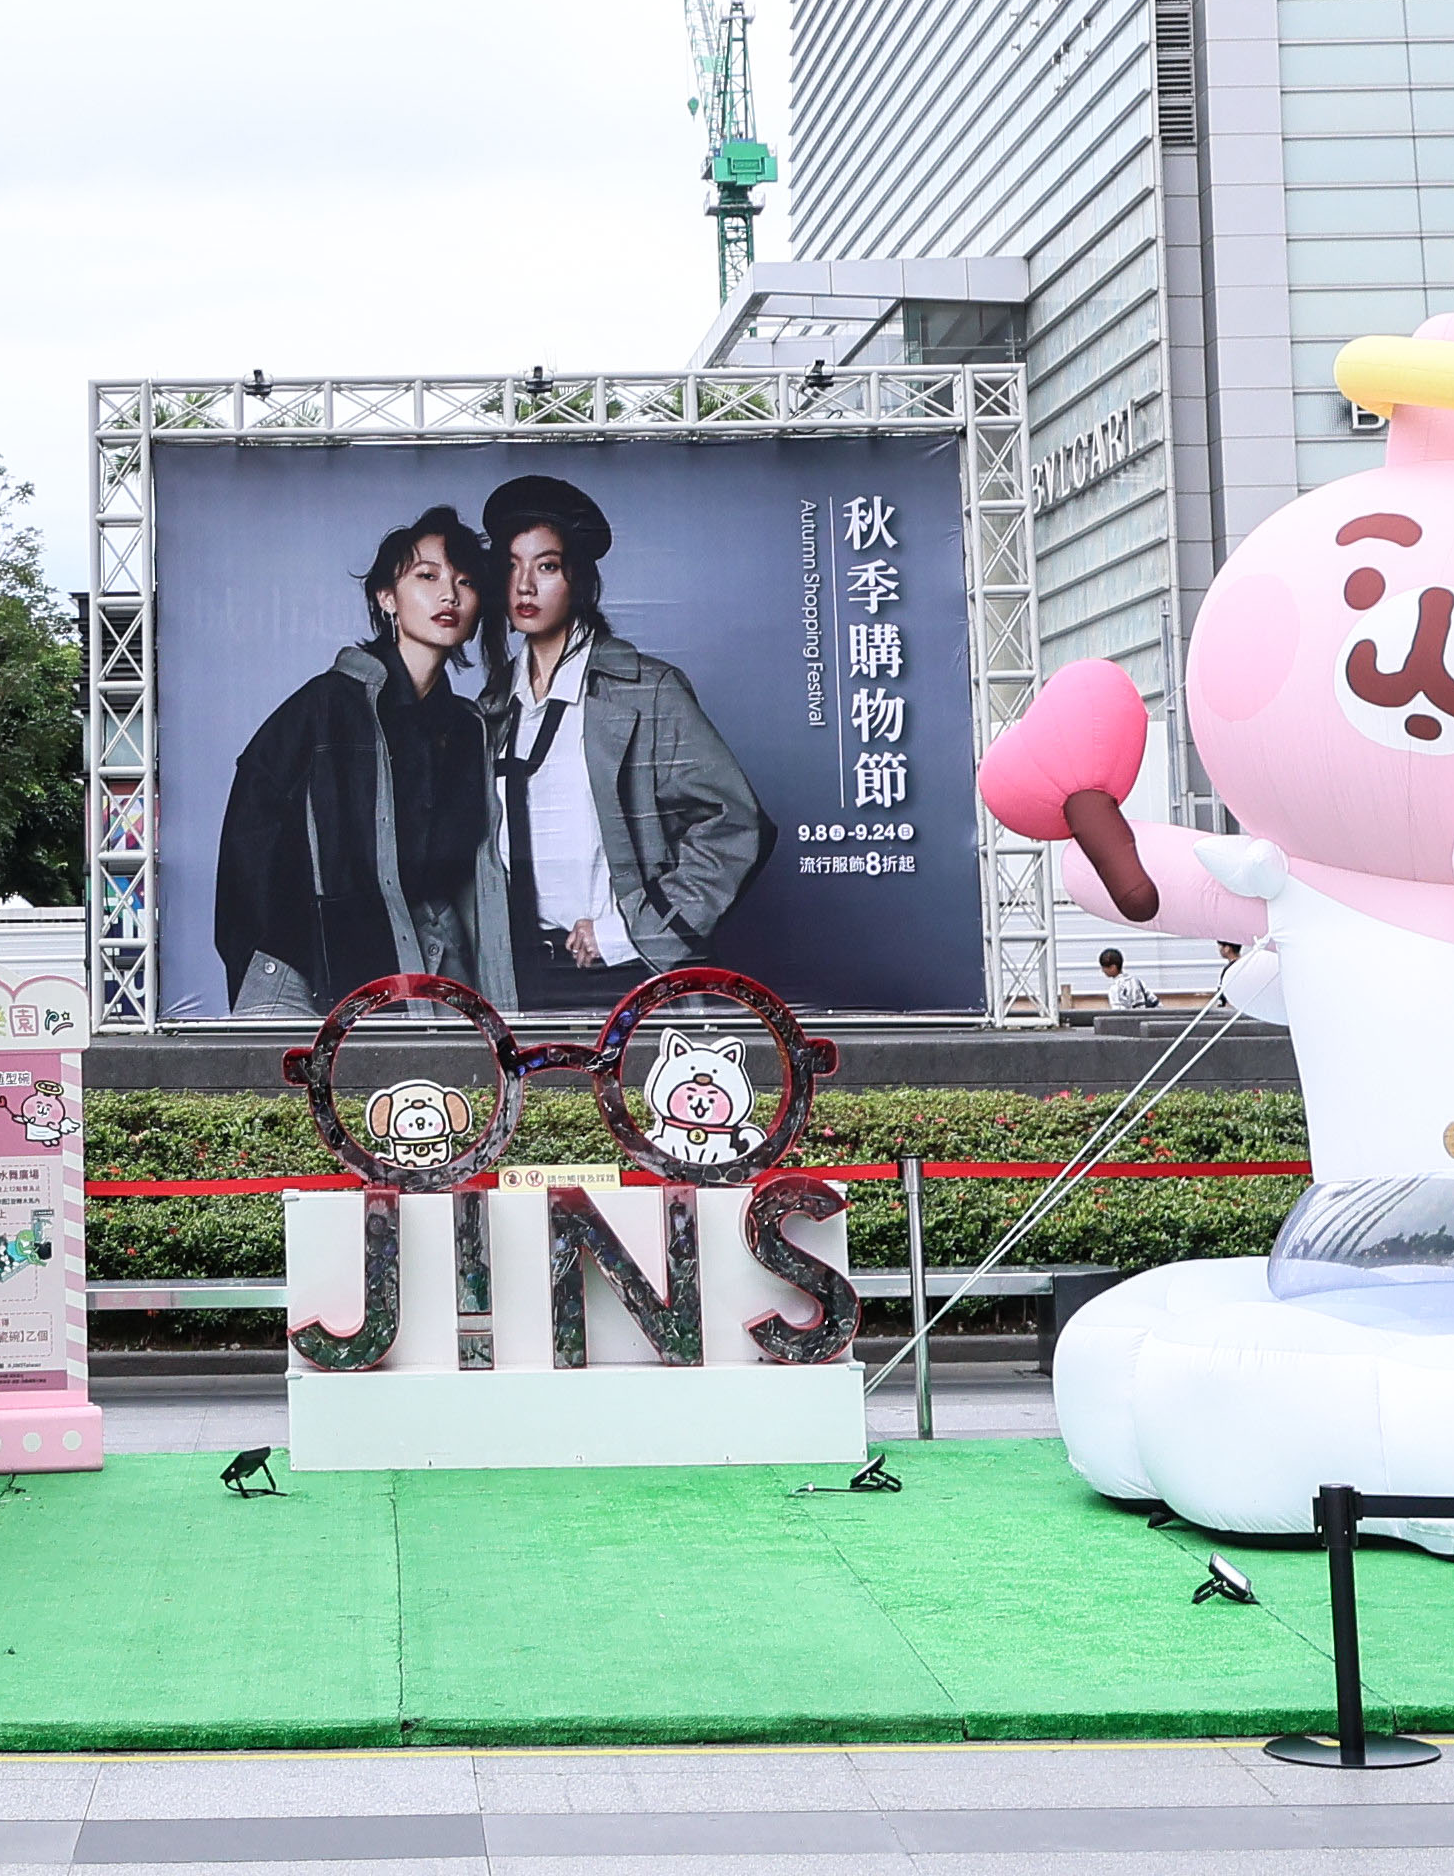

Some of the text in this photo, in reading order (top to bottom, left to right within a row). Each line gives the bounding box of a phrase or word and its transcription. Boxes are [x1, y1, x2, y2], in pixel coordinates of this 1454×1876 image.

[800, 499, 826, 727] Autumn Shopping Festival
[843, 495, 908, 809] 秋季購物節
[799, 851, 916, 875] 流行服飾8折起
